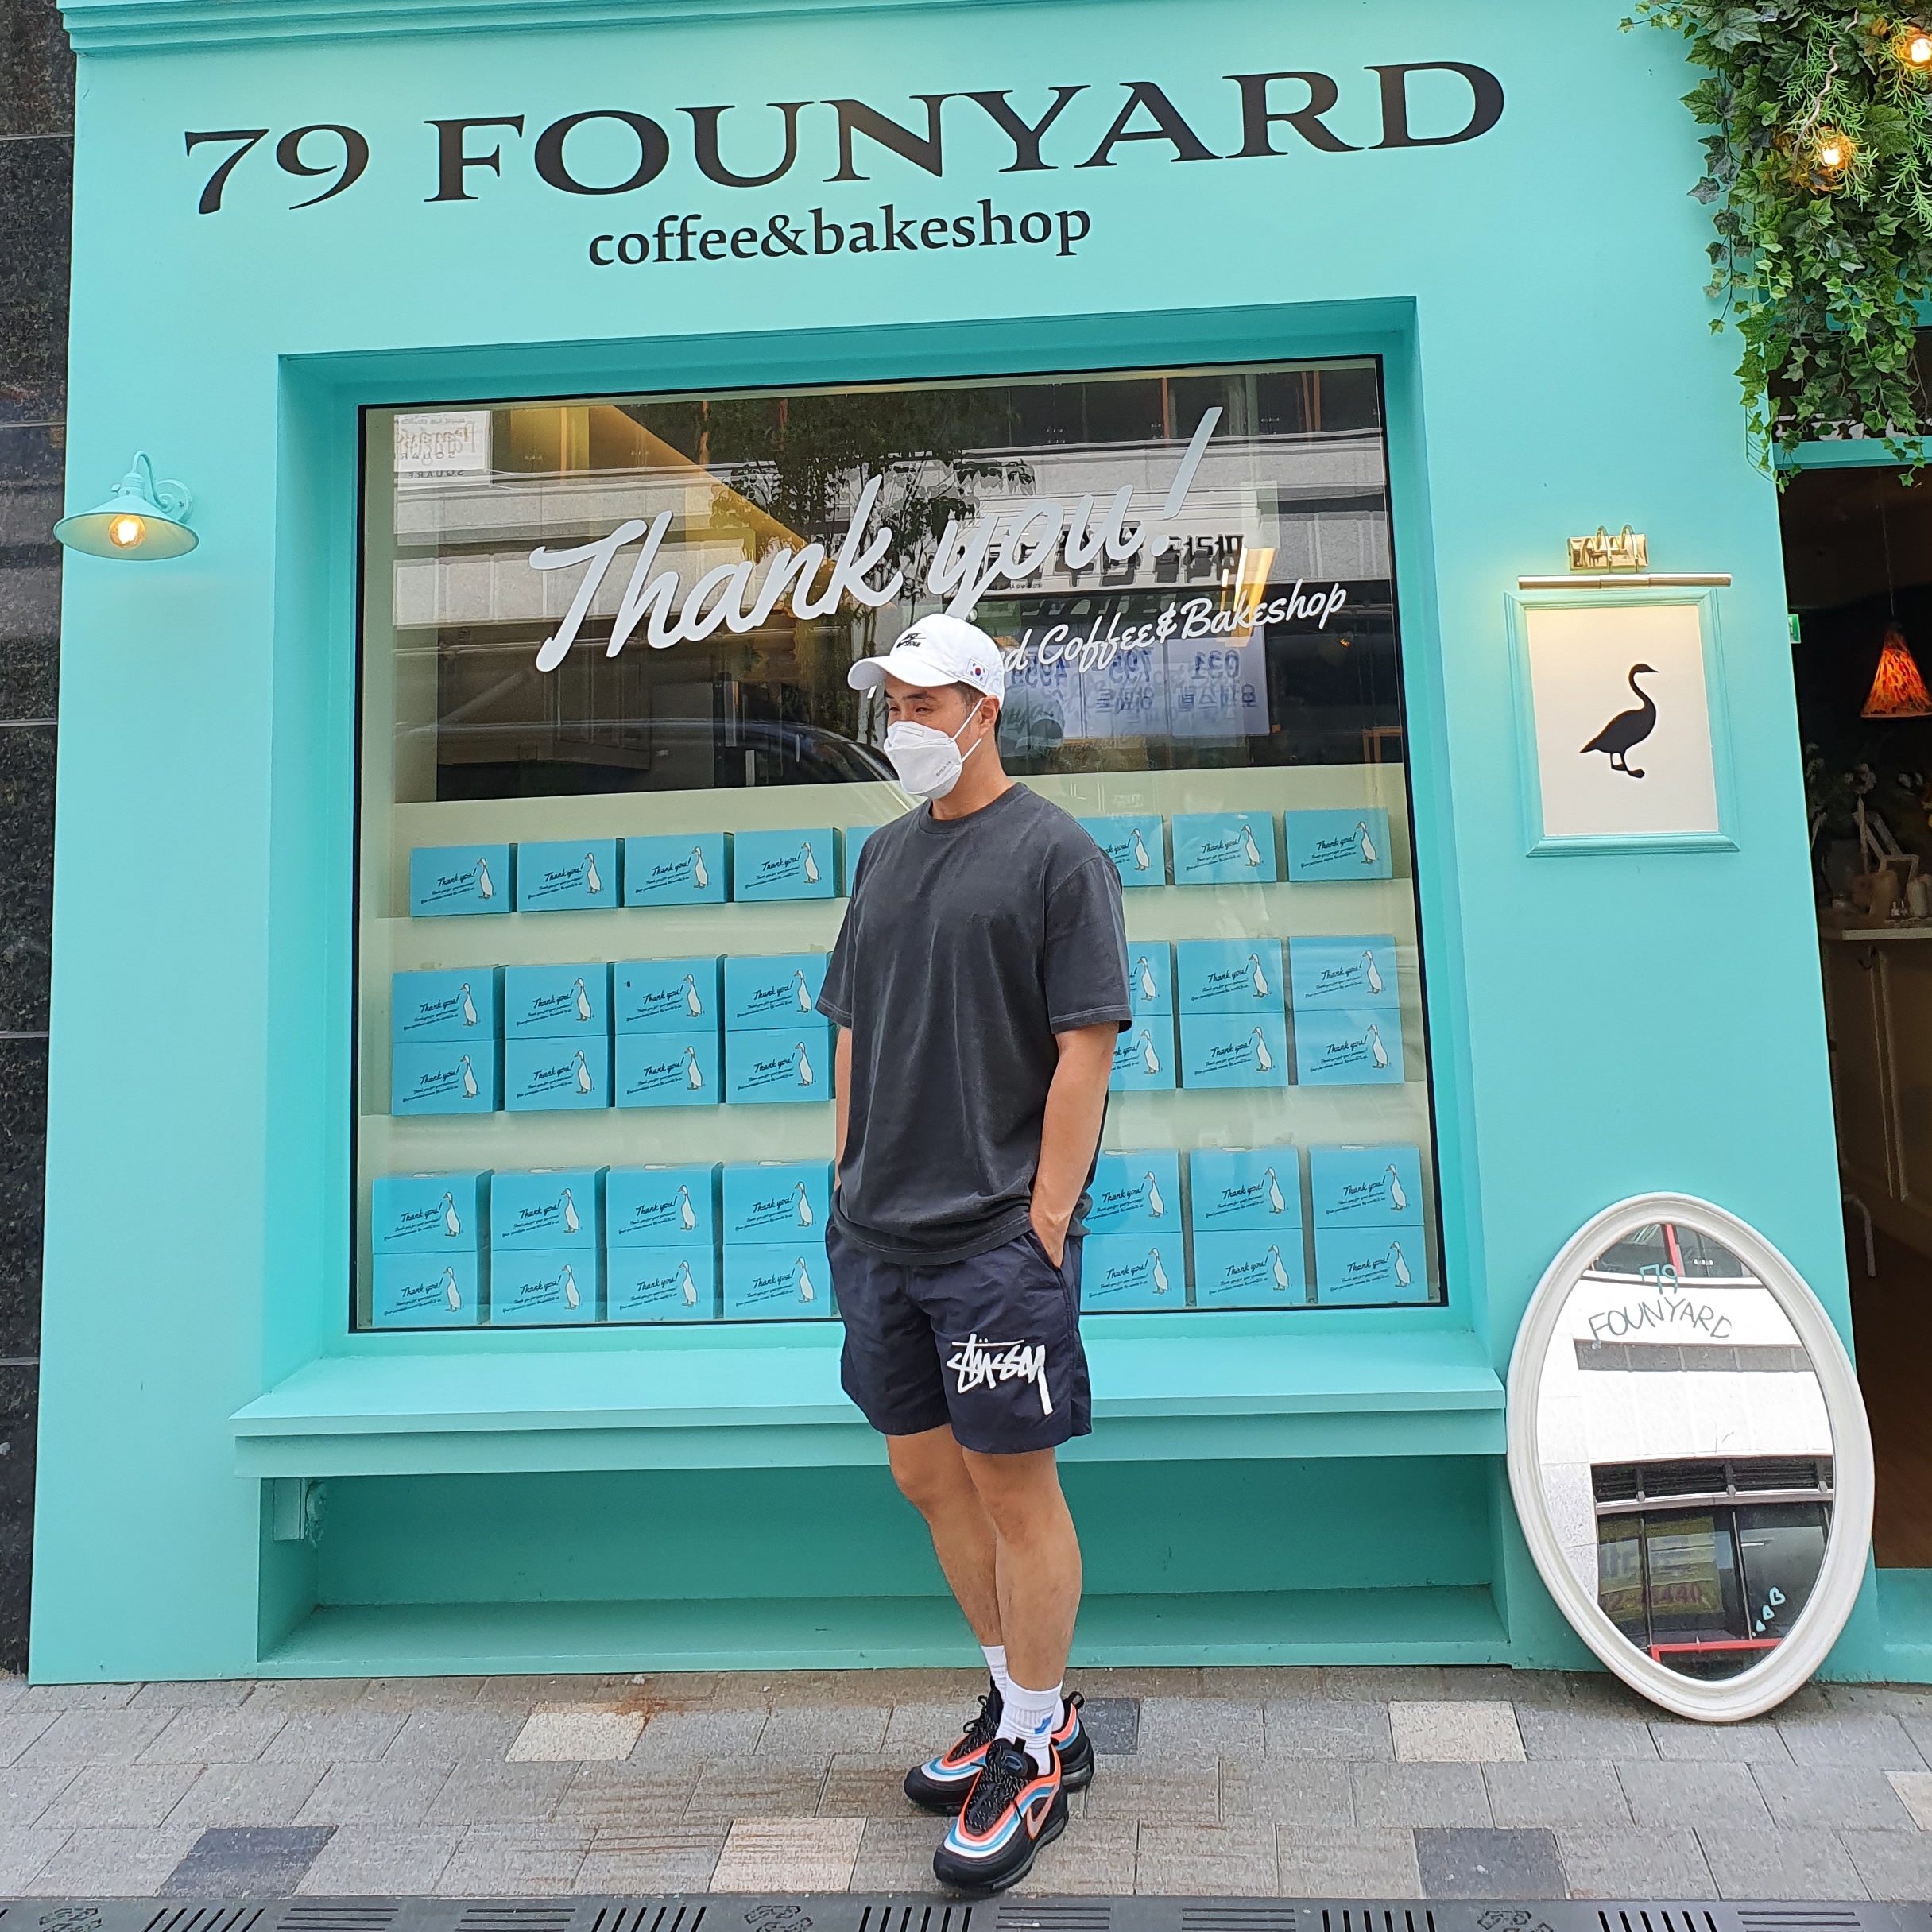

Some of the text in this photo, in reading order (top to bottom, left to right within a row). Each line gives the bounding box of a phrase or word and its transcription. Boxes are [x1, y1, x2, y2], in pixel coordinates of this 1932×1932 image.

[184, 60, 1506, 215] 79 FOUNYARD
[589, 199, 1091, 265] coffee&bakeshop
[528, 406, 1224, 672] Thank you!
[1202, 834, 1241, 853] Thank you!
[1316, 833, 1357, 851] Thank you!
[651, 857, 691, 876] Thank you!
[761, 852, 801, 871] Thank you!
[437, 868, 477, 887] Thank you!
[544, 862, 584, 882] Thank you!
[1207, 964, 1249, 983] Thank you!
[1322, 962, 1362, 980] Thank you!
[532, 989, 574, 1009] Thank you!
[643, 985, 683, 1005] Thank you!
[753, 980, 794, 1000] Thank you!
[420, 994, 460, 1014] Thank you!
[1210, 1038, 1252, 1057] Thank you!
[1326, 1034, 1368, 1054] Thank you!
[533, 1061, 574, 1081] Thank you!
[644, 1057, 684, 1077] Thank you!
[753, 1053, 795, 1073] Thank you!
[420, 1065, 461, 1084] Thank you!
[1102, 1183, 1144, 1202] Thank you!
[1222, 1179, 1264, 1199] Thank you!
[1343, 1176, 1386, 1196] Thank you!
[401, 1202, 443, 1222] Thank you!
[519, 1199, 561, 1219] Thank you!
[636, 1197, 677, 1216] Thank you!
[752, 1193, 795, 1213] Thank you!
[1105, 1259, 1148, 1280] Thank you!
[1226, 1256, 1268, 1276] Thank you!
[1347, 1253, 1390, 1273] Thank you!
[401, 1277, 443, 1297] Thank you!
[520, 1275, 562, 1295] Thank you!
[637, 1272, 679, 1291] Thank you!
[753, 1268, 795, 1288] Thank you!
[1639, 1264, 1679, 1295] 79
[1588, 1296, 1733, 1343] FOUNYARD
